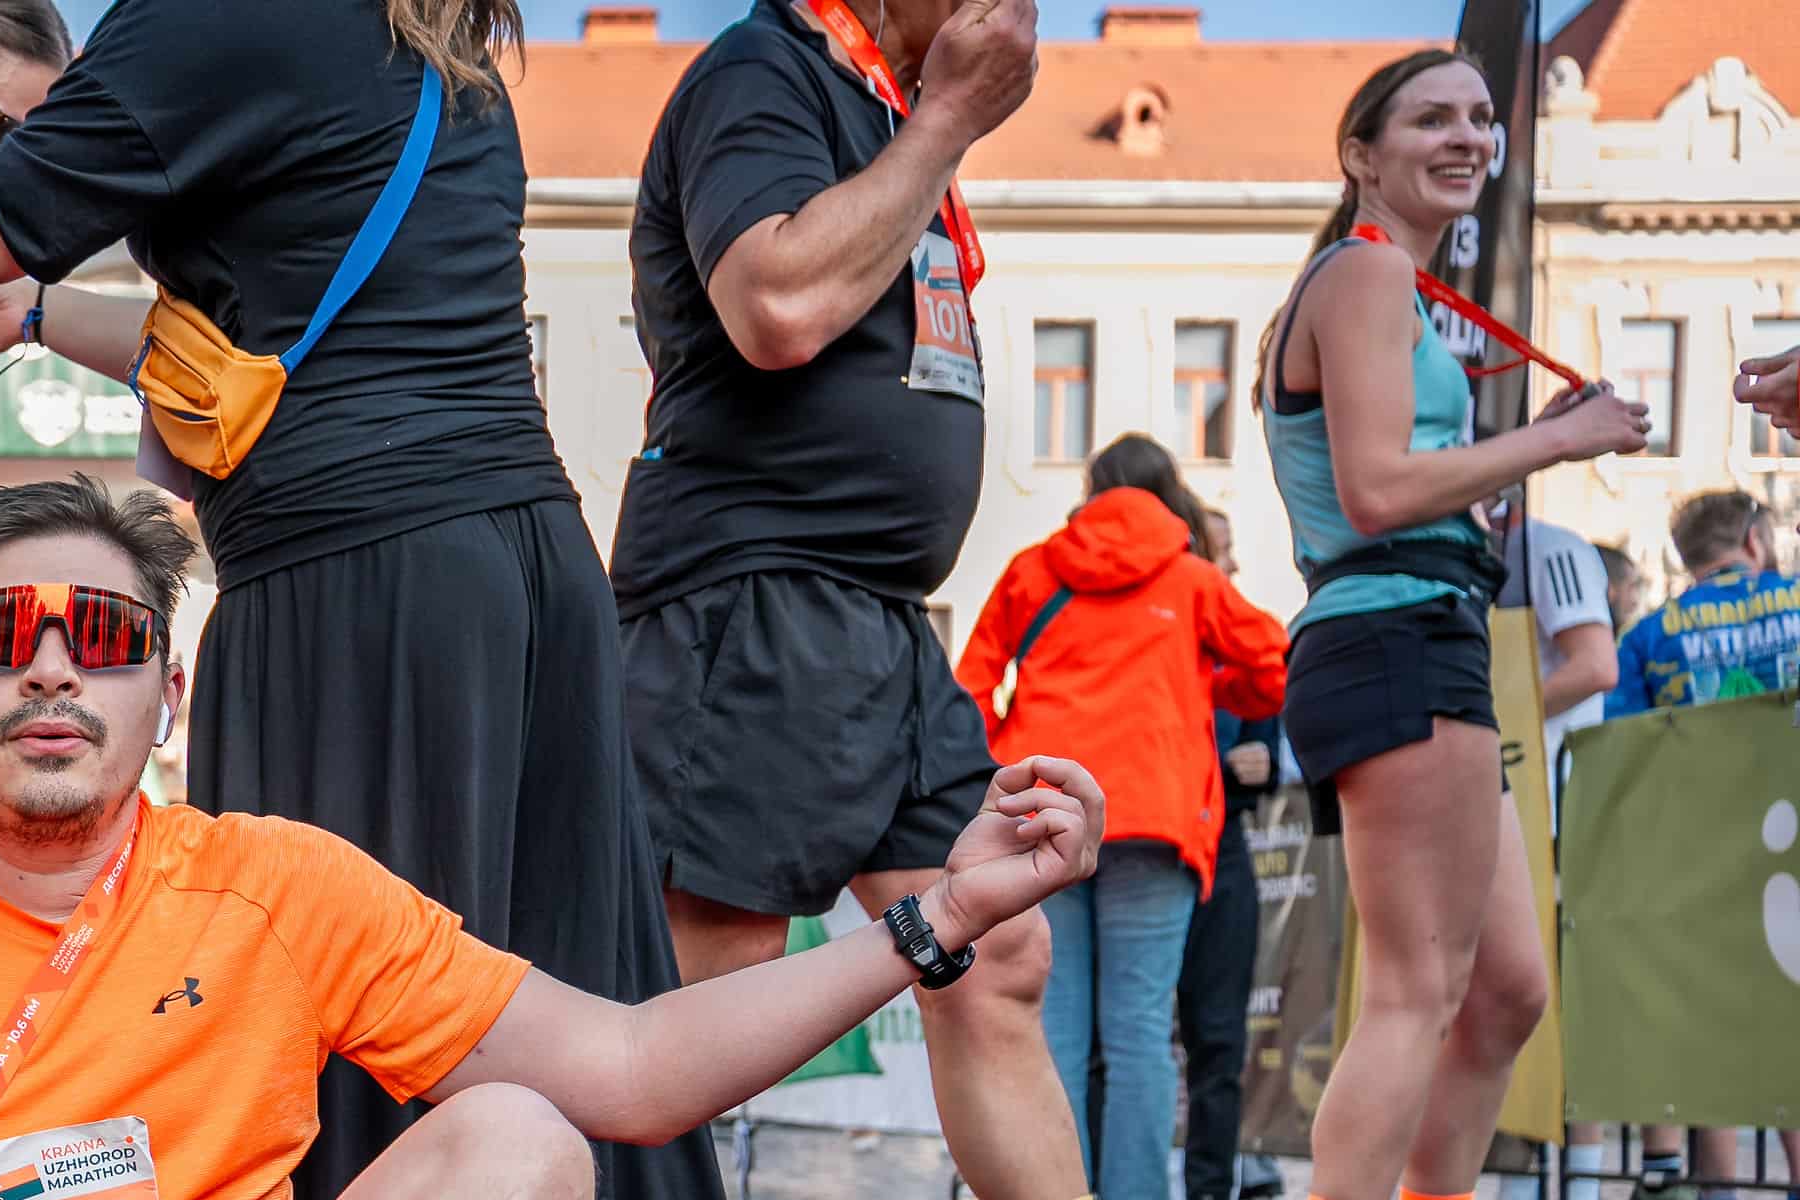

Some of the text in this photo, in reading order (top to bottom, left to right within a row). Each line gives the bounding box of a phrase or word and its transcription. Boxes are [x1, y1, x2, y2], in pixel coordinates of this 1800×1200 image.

[49, 932, 75, 968] KRAYNA
[7, 1019, 28, 1044] 10,6
[22, 998, 40, 1020] КМ
[41, 1135, 106, 1161] KRAYNA
[44, 1147, 136, 1175] UZHHOROD
[47, 1161, 138, 1192] MARATHON
